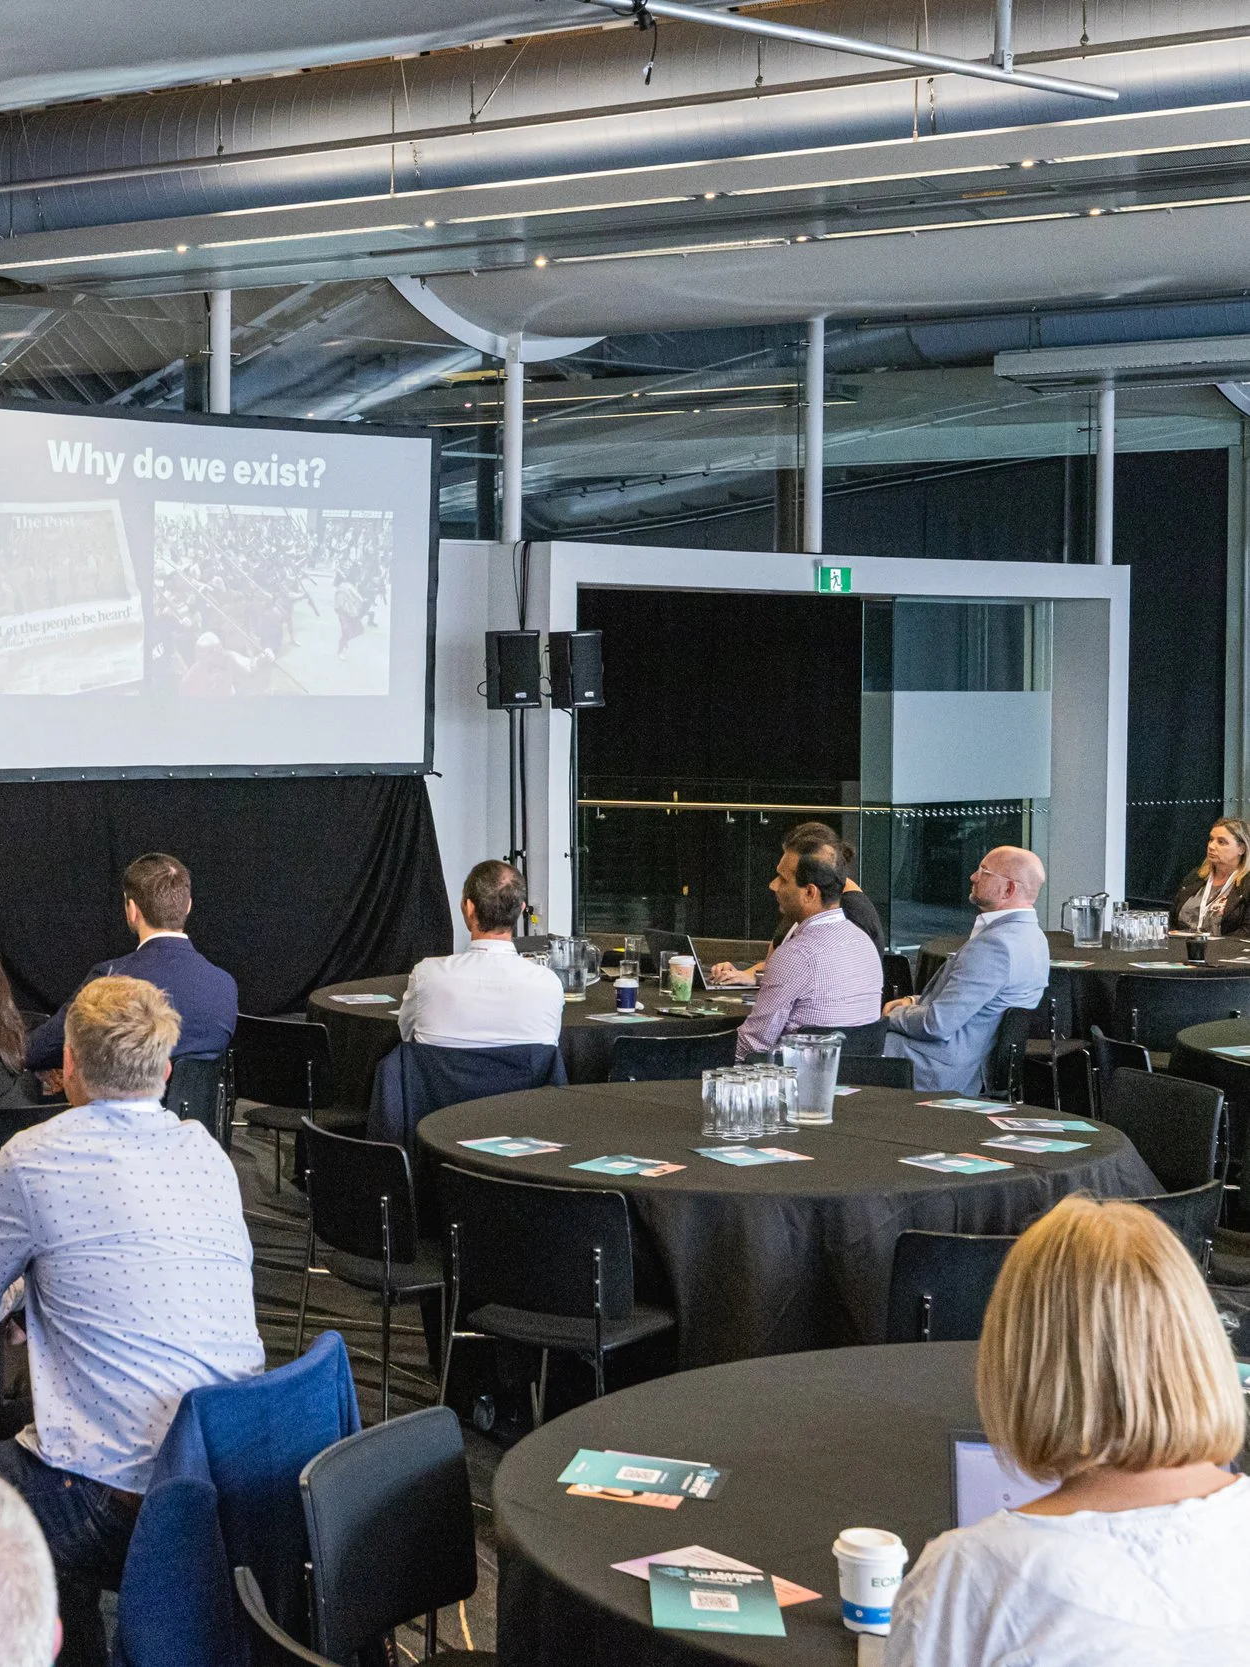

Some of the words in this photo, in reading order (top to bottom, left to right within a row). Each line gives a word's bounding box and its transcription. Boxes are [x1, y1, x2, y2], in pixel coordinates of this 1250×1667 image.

[47, 439, 126, 484] Why
[132, 447, 174, 481] do
[180, 456, 226, 483] we
[233, 454, 326, 488] exist?
